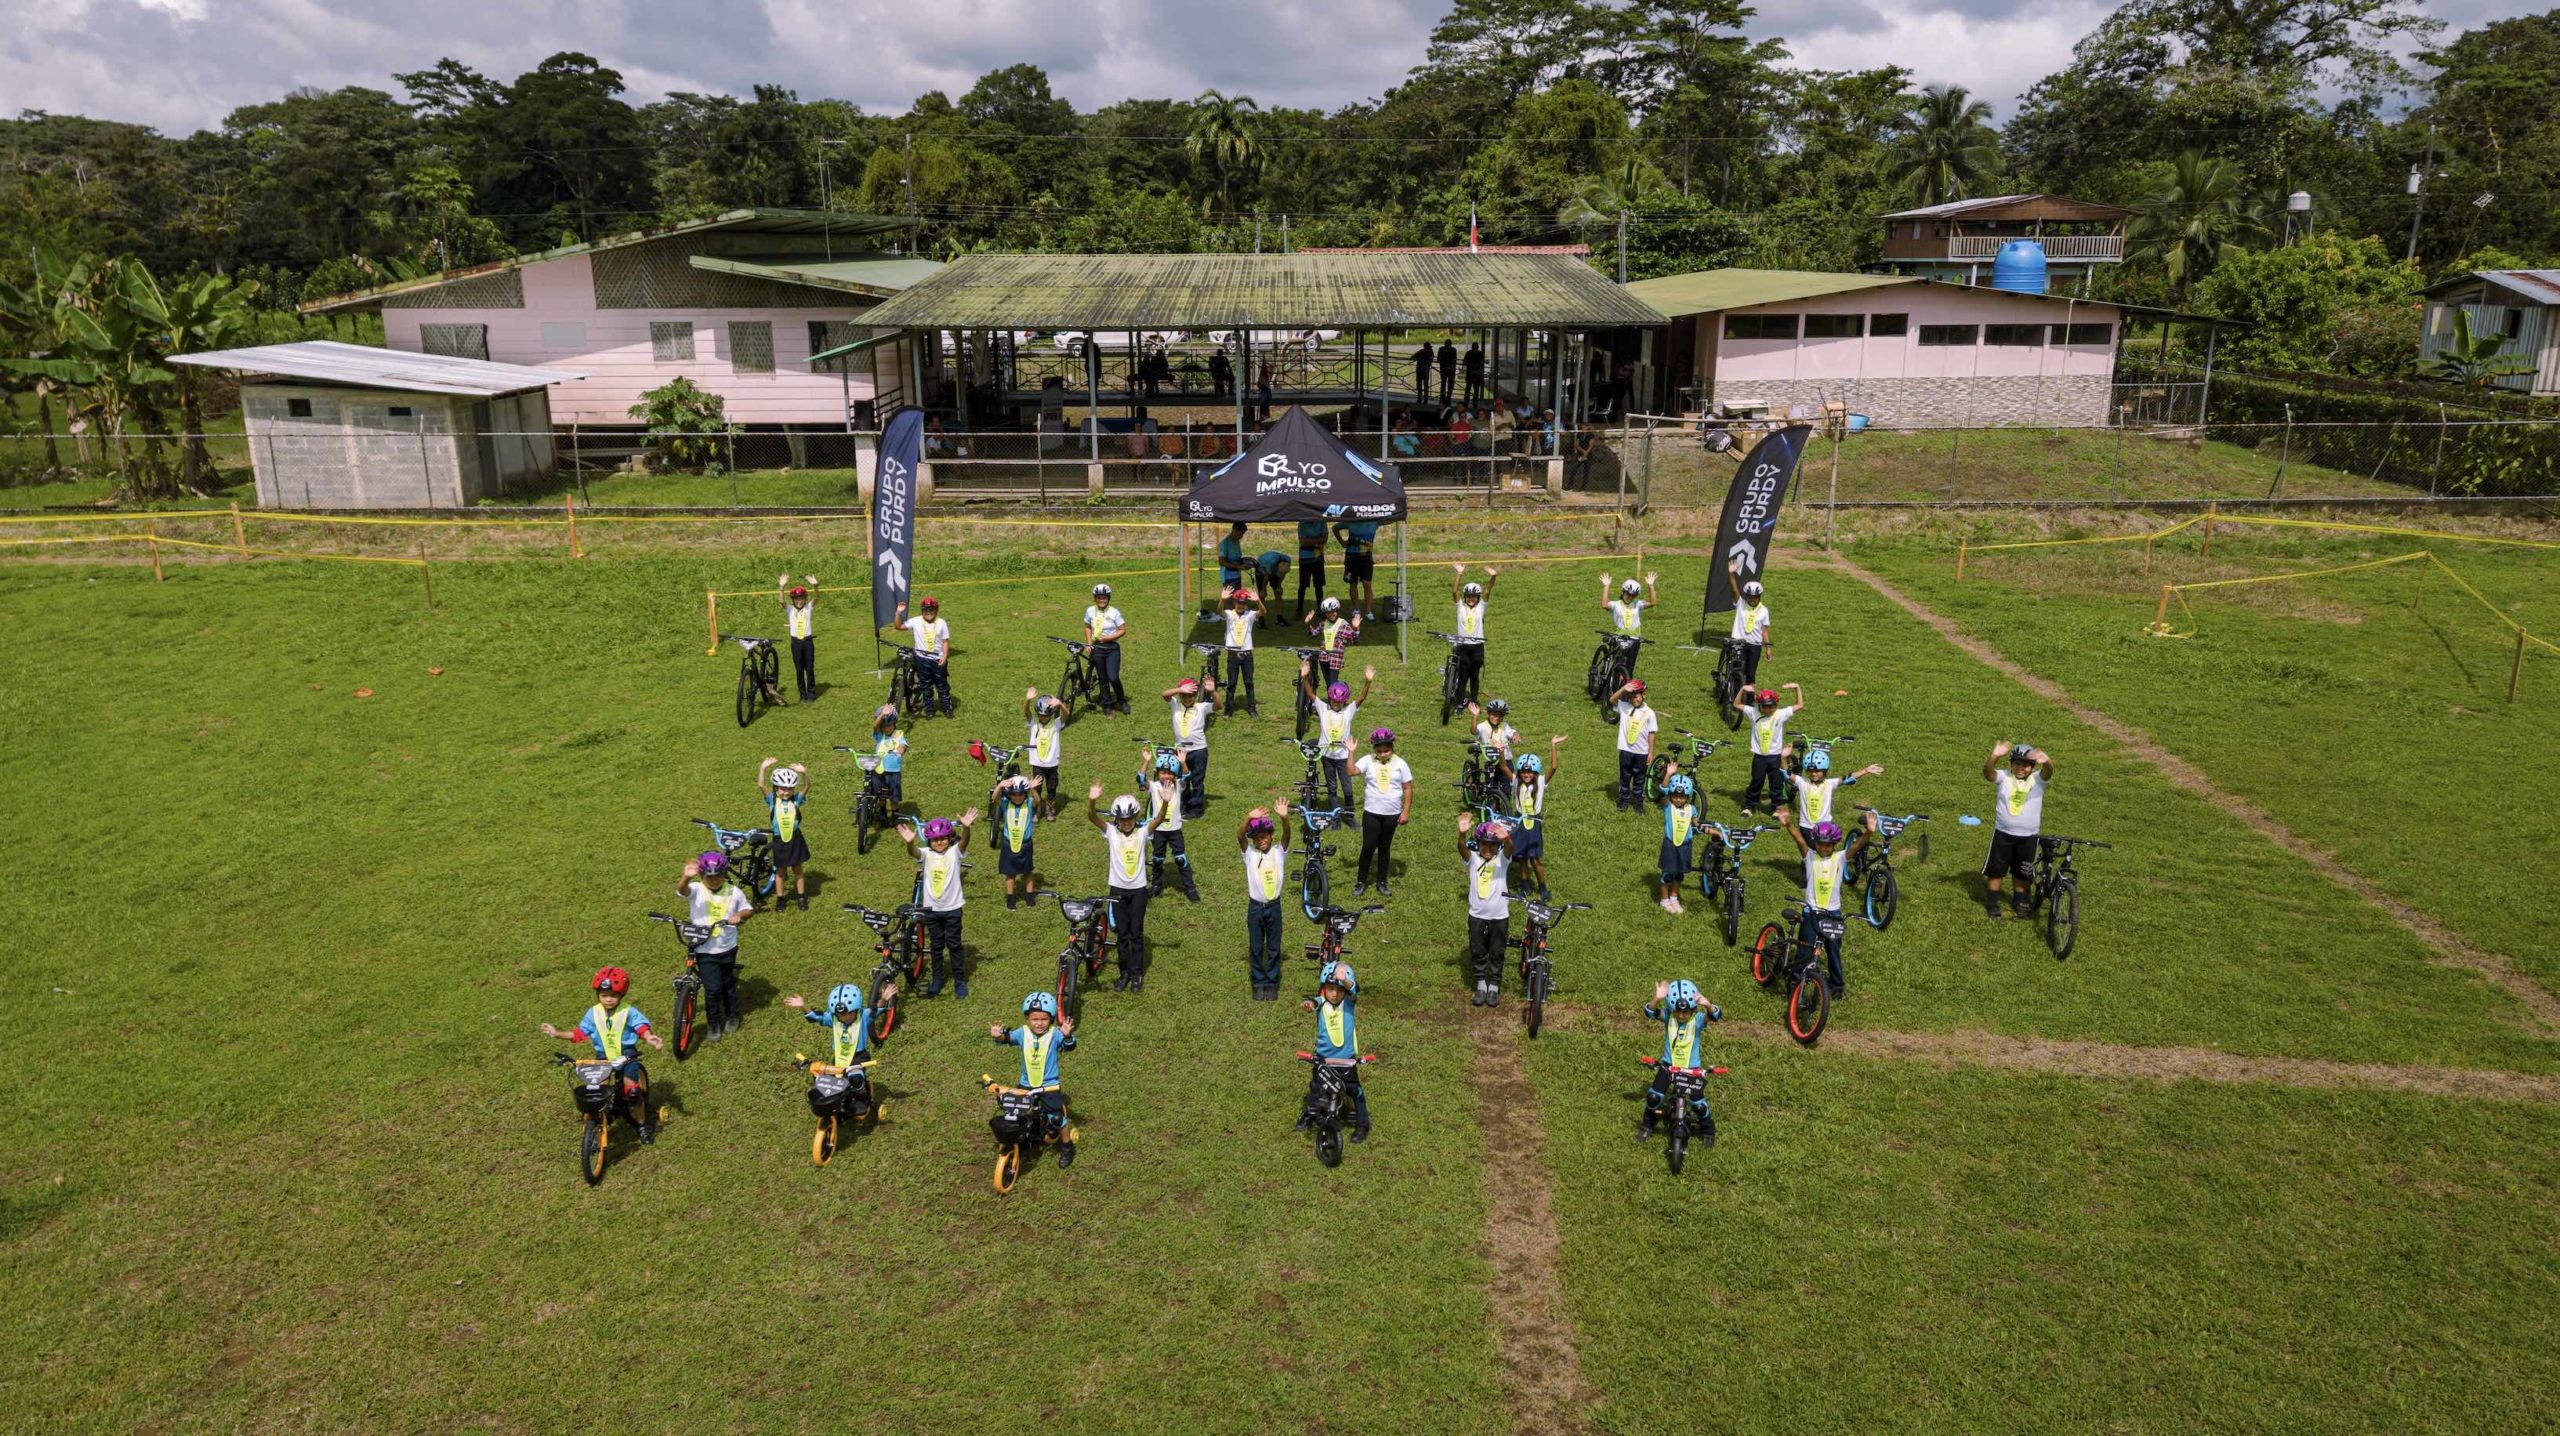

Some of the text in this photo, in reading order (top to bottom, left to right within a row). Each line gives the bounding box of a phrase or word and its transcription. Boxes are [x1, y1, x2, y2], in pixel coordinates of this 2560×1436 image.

[879, 456, 896, 539] GRUPO
[890, 461, 907, 544] PURDY
[1256, 476, 1332, 493] IMPULSO
[1298, 461, 1327, 476] YO
[1735, 463, 1768, 534] GRUPO
[1748, 464, 1781, 534] PURDY
[1352, 503, 1397, 512] TOLDOS
